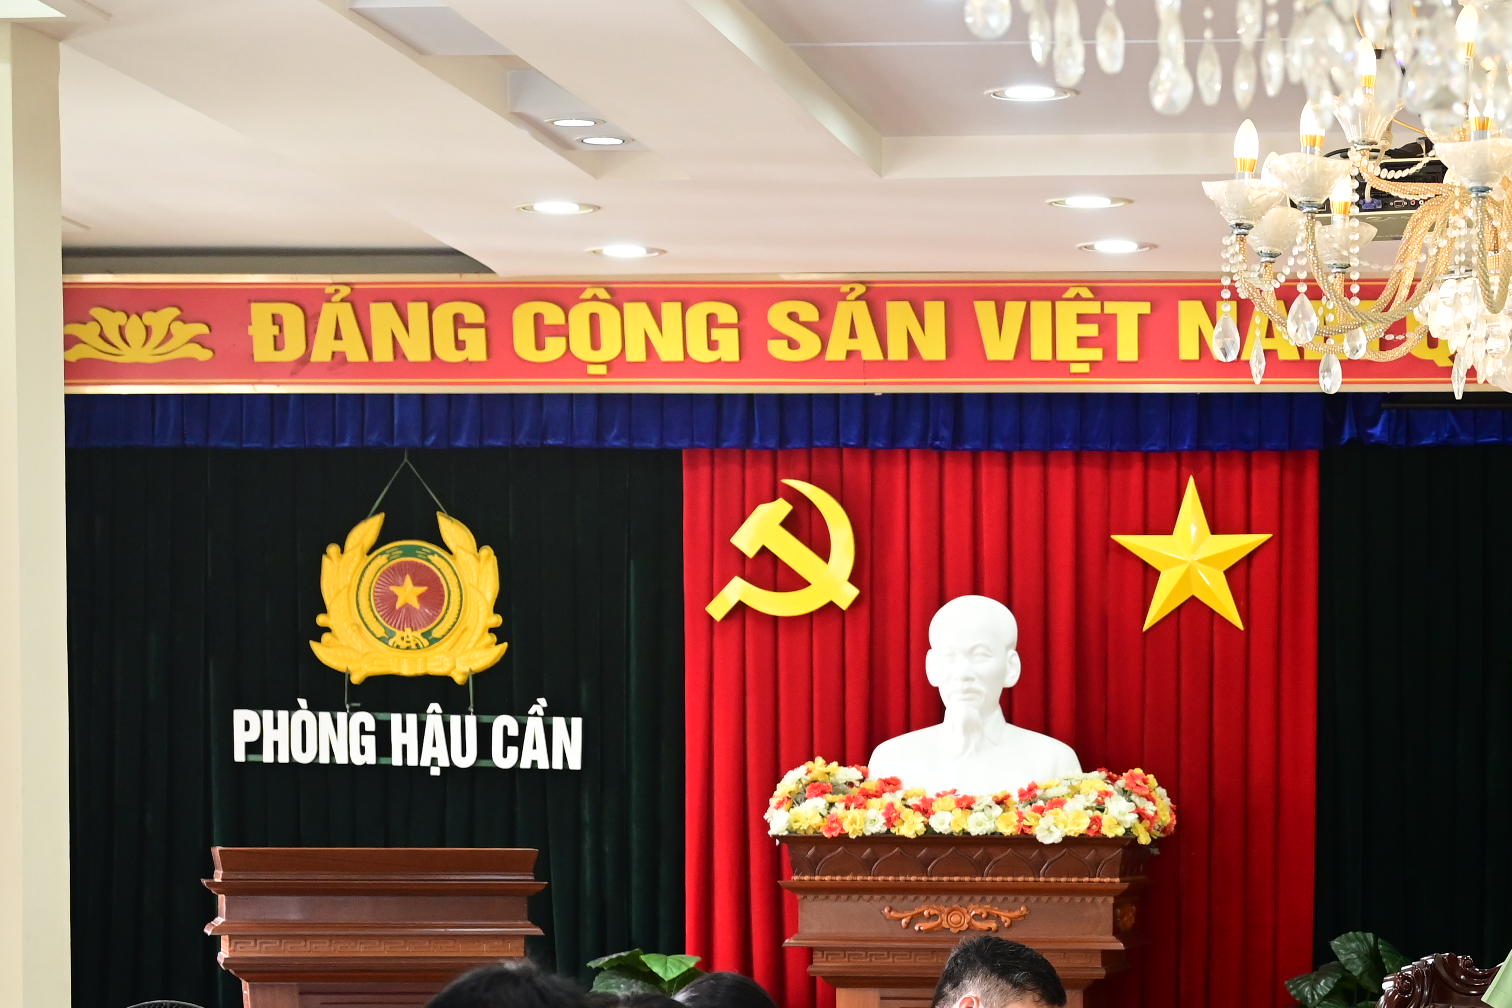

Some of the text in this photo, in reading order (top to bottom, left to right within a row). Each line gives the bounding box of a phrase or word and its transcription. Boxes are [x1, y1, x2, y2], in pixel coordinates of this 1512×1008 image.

[249, 283, 487, 363] ĐẢNG
[513, 286, 741, 376] CỘNG
[767, 282, 948, 362] SẢN
[974, 285, 1153, 374] VIỆT
[232, 696, 584, 777] PHÒNG HẬU CẦN
